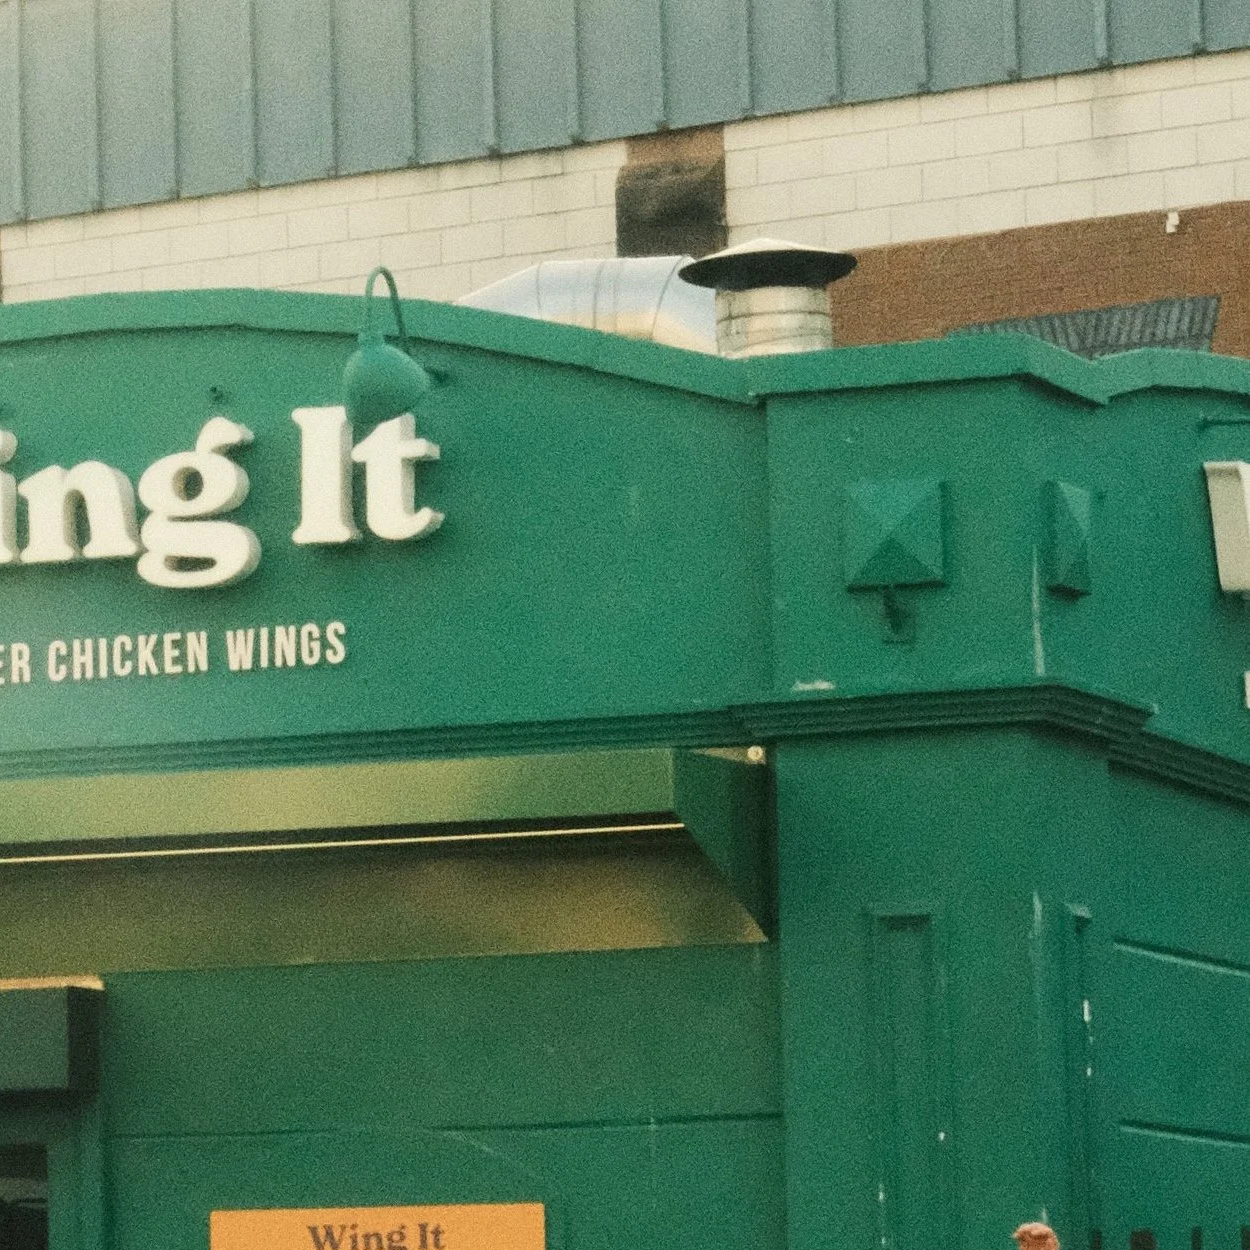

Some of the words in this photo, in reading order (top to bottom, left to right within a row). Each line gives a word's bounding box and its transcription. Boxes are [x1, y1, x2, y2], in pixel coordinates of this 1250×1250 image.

[290, 405, 445, 547] It
[47, 631, 209, 683] CHICKEN
[226, 622, 347, 671] WINGS
[418, 1222, 446, 1250] It
